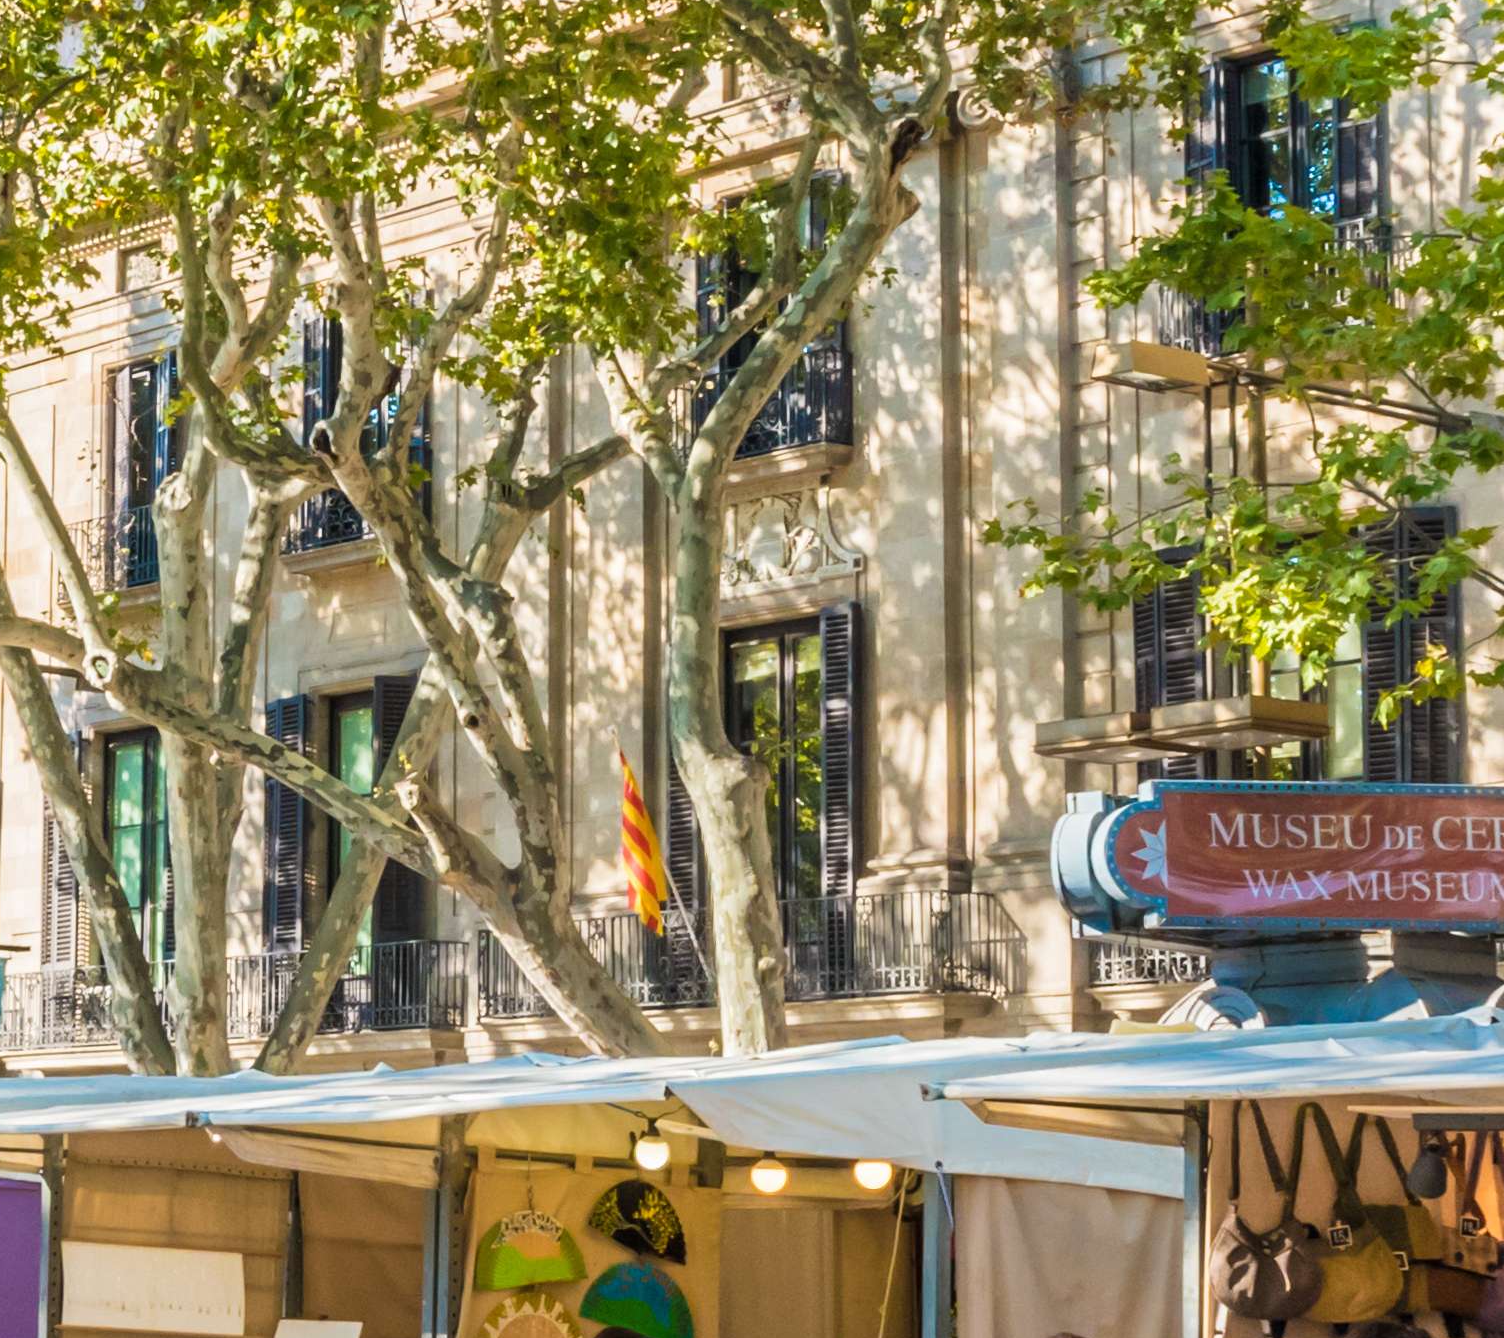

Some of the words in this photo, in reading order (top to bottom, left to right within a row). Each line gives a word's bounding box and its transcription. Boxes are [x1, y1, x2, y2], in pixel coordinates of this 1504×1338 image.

[1208, 812, 1372, 849] MUSEU
[1383, 825, 1424, 851] DE
[1243, 869, 1334, 901] WAX
